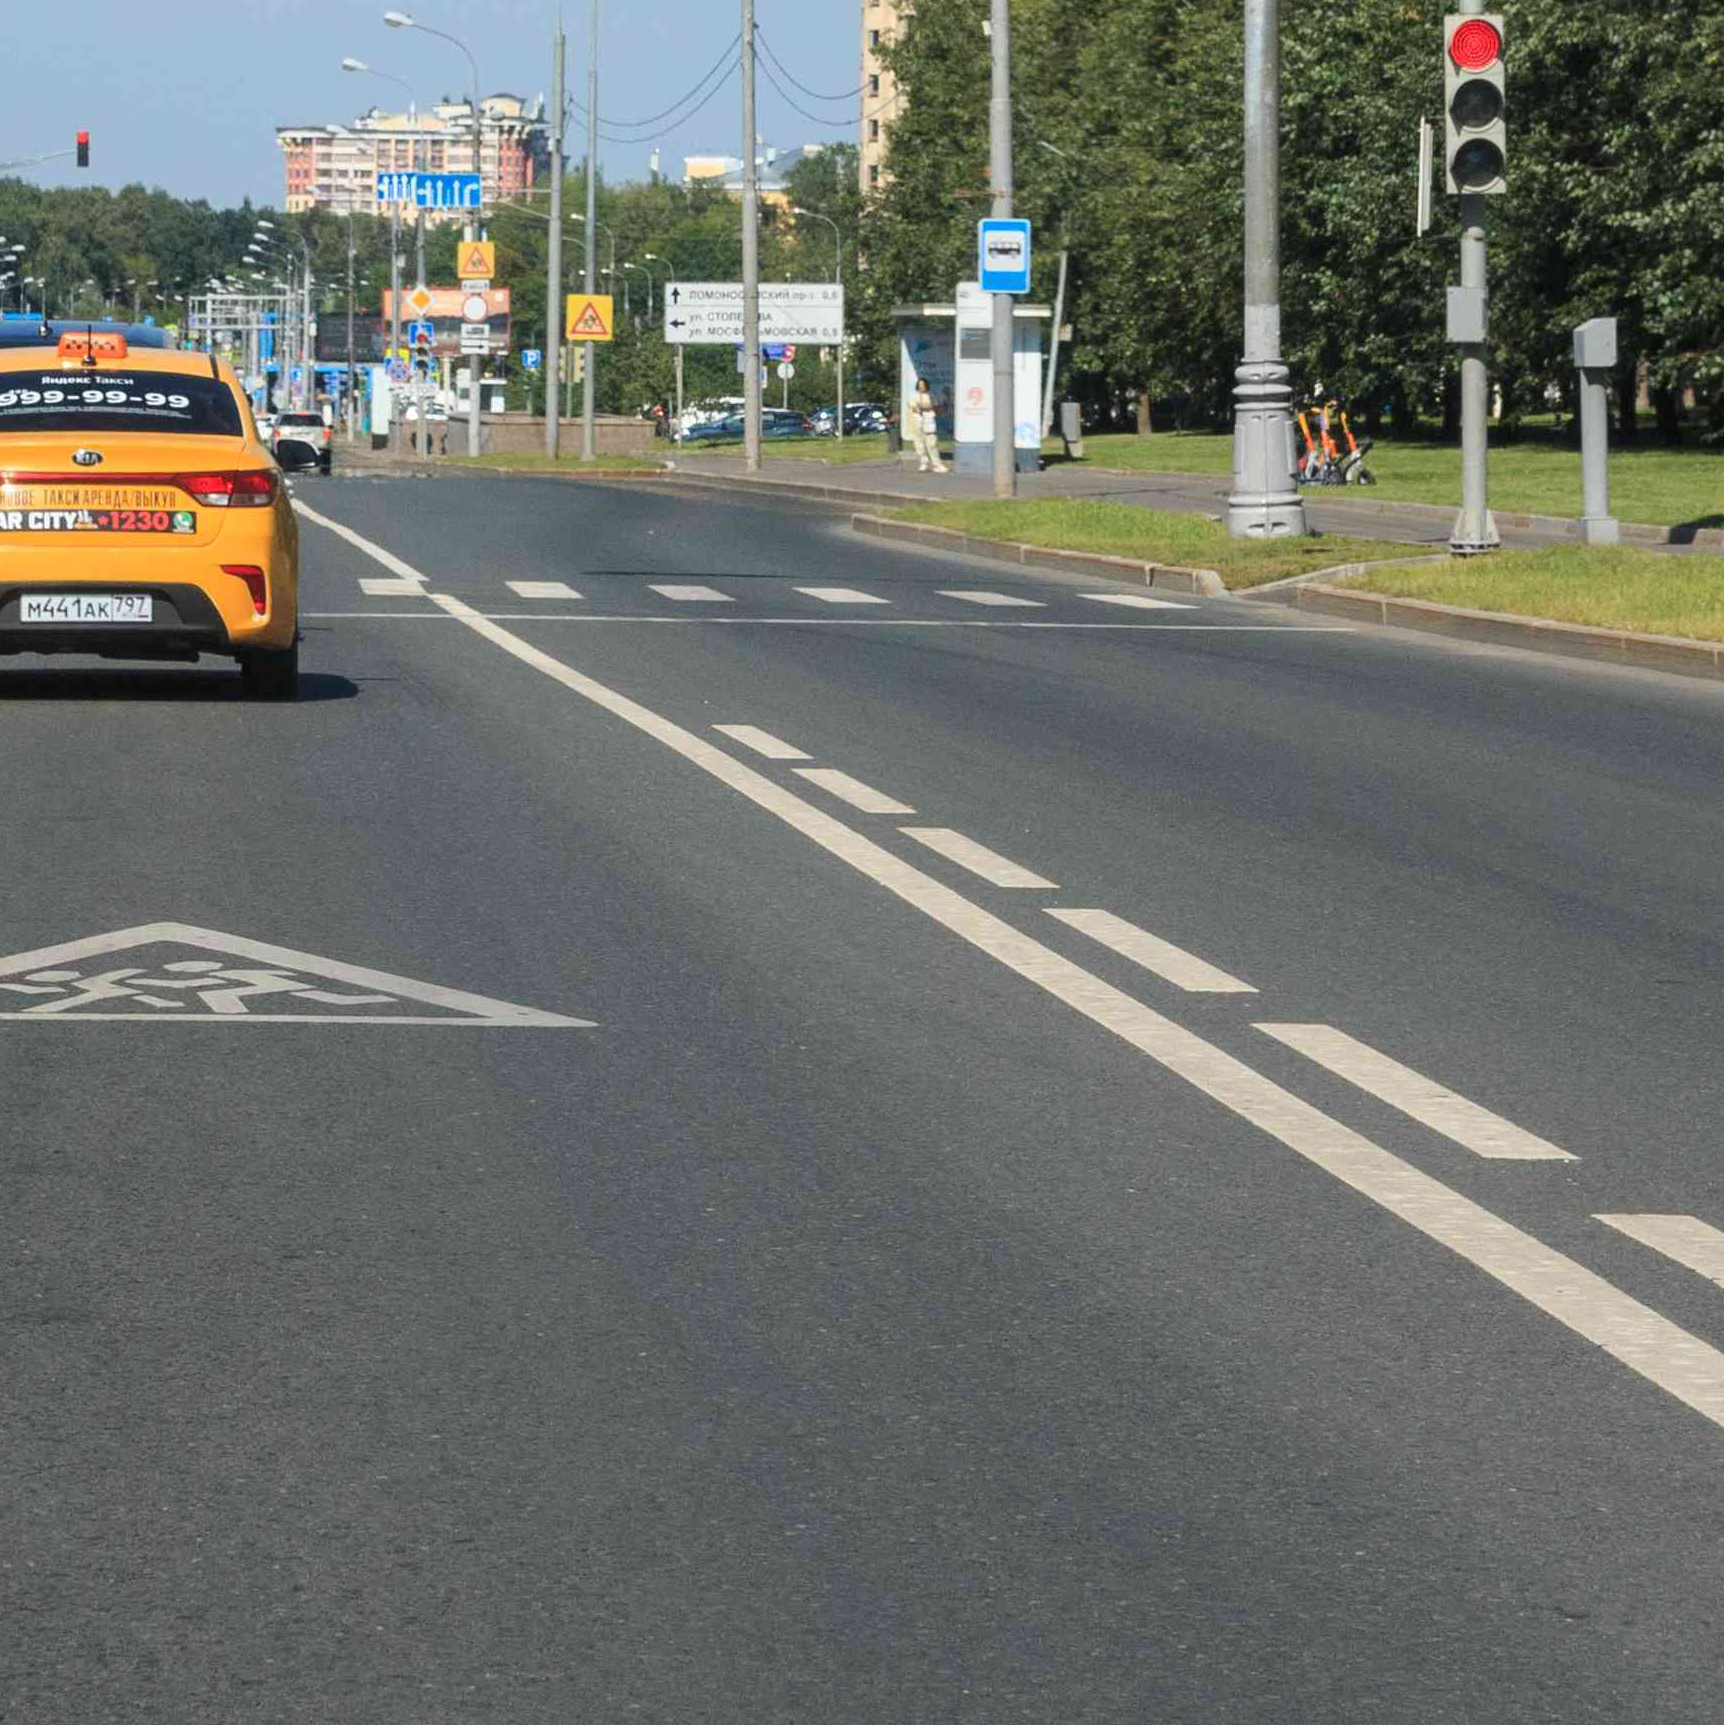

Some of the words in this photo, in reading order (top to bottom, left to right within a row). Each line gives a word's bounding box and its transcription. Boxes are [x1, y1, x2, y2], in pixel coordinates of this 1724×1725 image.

[41, 376, 92, 386] Яндекс
[94, 376, 135, 386] Такси
[44, 489, 79, 506] ТАКСИ
[28, 511, 77, 530] CITY
[114, 596, 146, 613] 797
